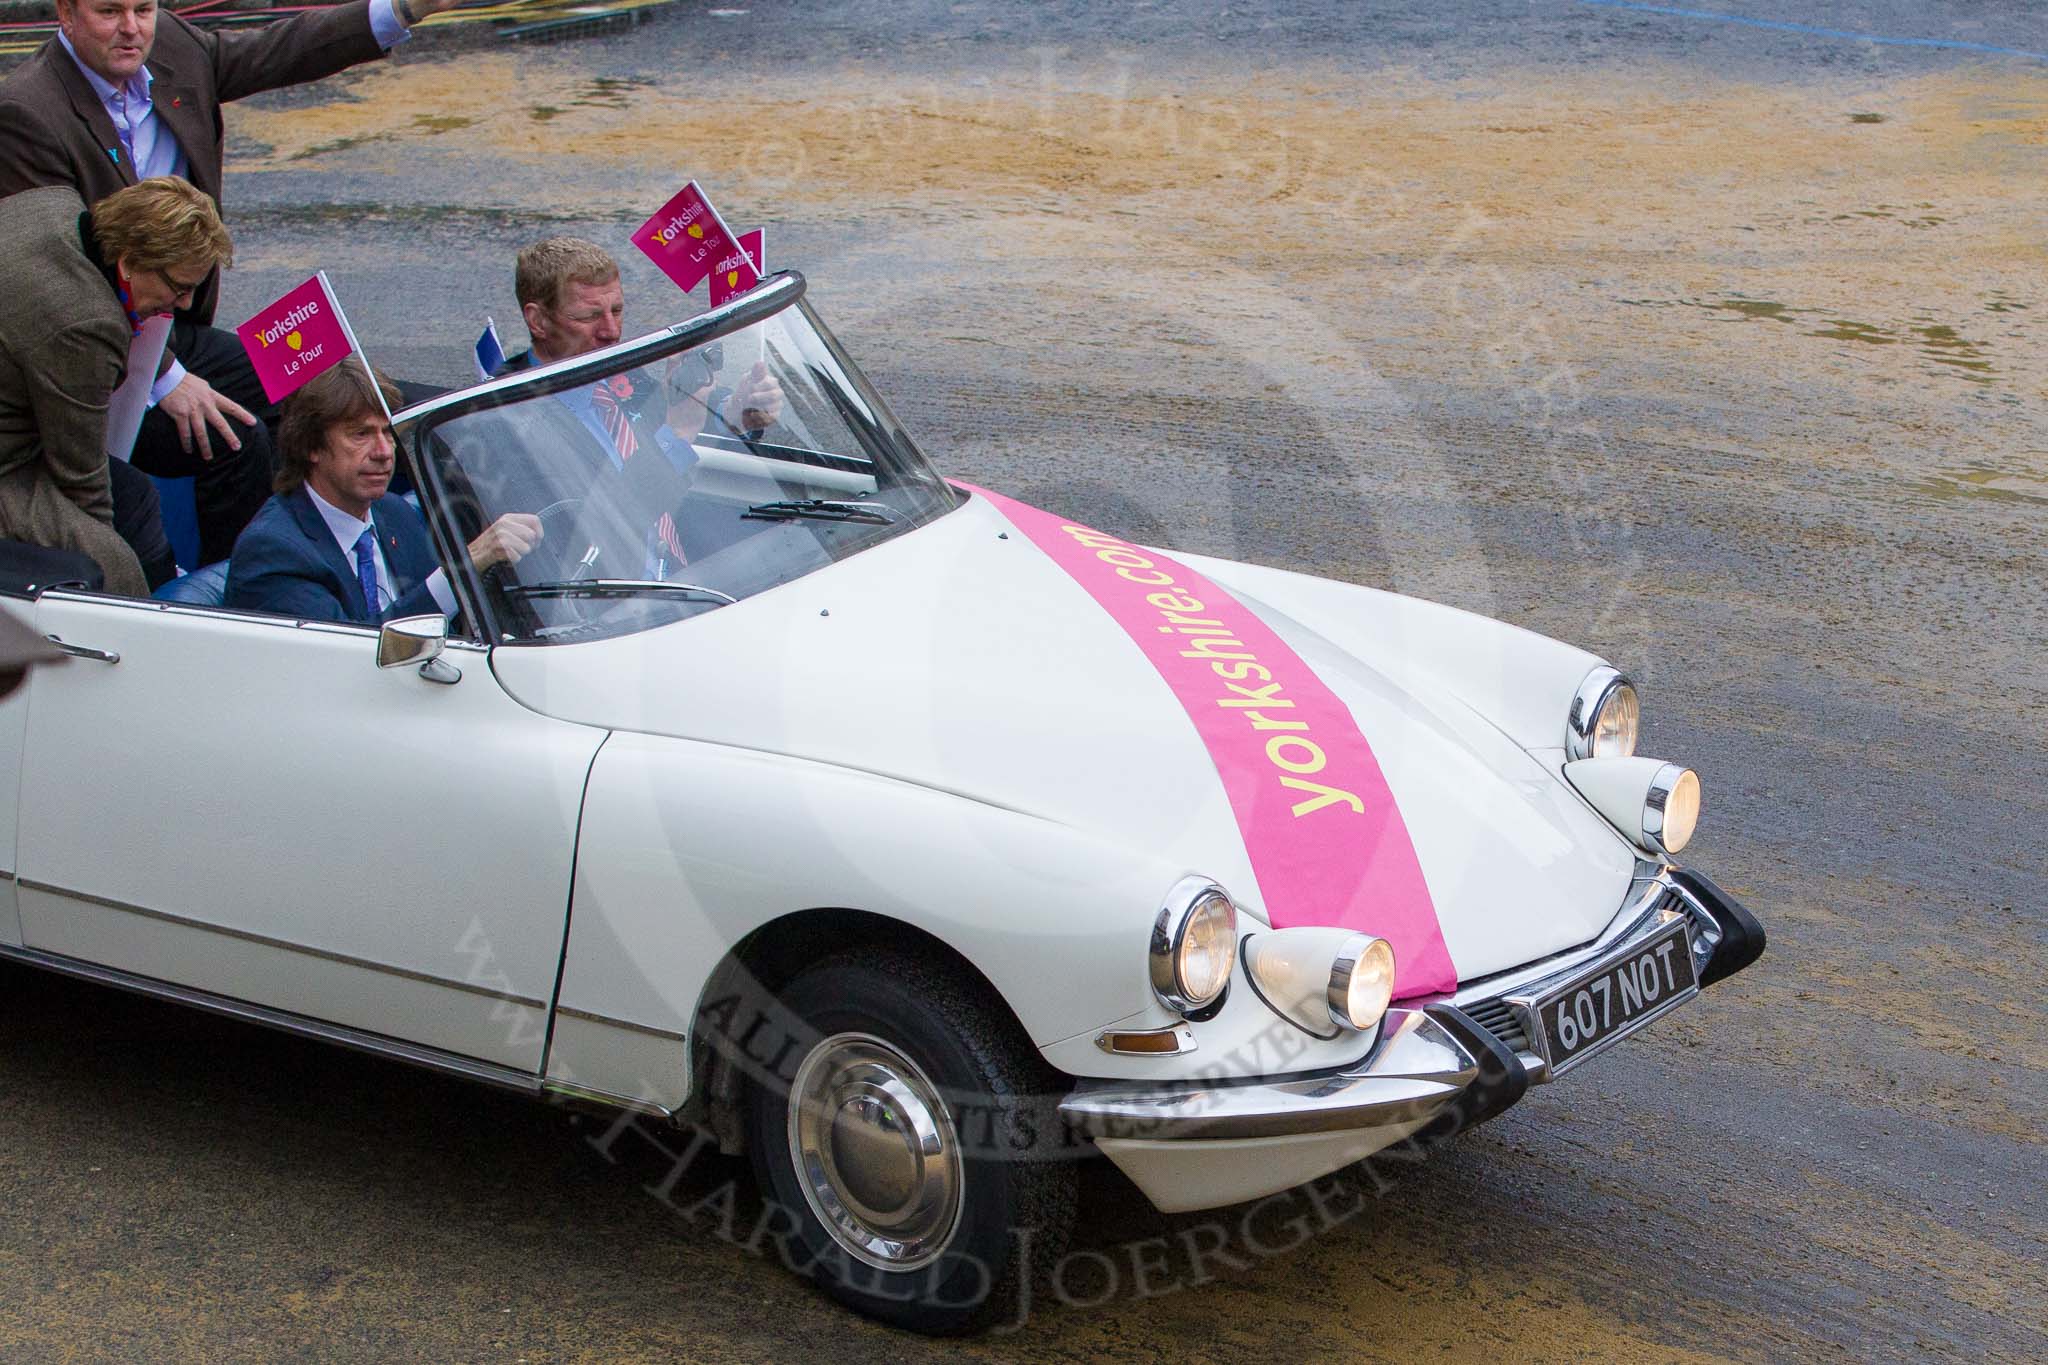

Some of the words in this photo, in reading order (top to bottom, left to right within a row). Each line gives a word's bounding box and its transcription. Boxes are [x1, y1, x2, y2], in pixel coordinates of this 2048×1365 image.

[652, 202, 704, 246] Yorkshire
[690, 249, 707, 263] Le
[715, 250, 754, 275] orkshie
[256, 301, 320, 348] Yorkshire
[283, 361, 301, 376] Le
[299, 343, 323, 365] Tour
[1061, 524, 1365, 817] yorkshire.com
[1557, 976, 1613, 1051] 607
[1616, 940, 1676, 1016] NOT
